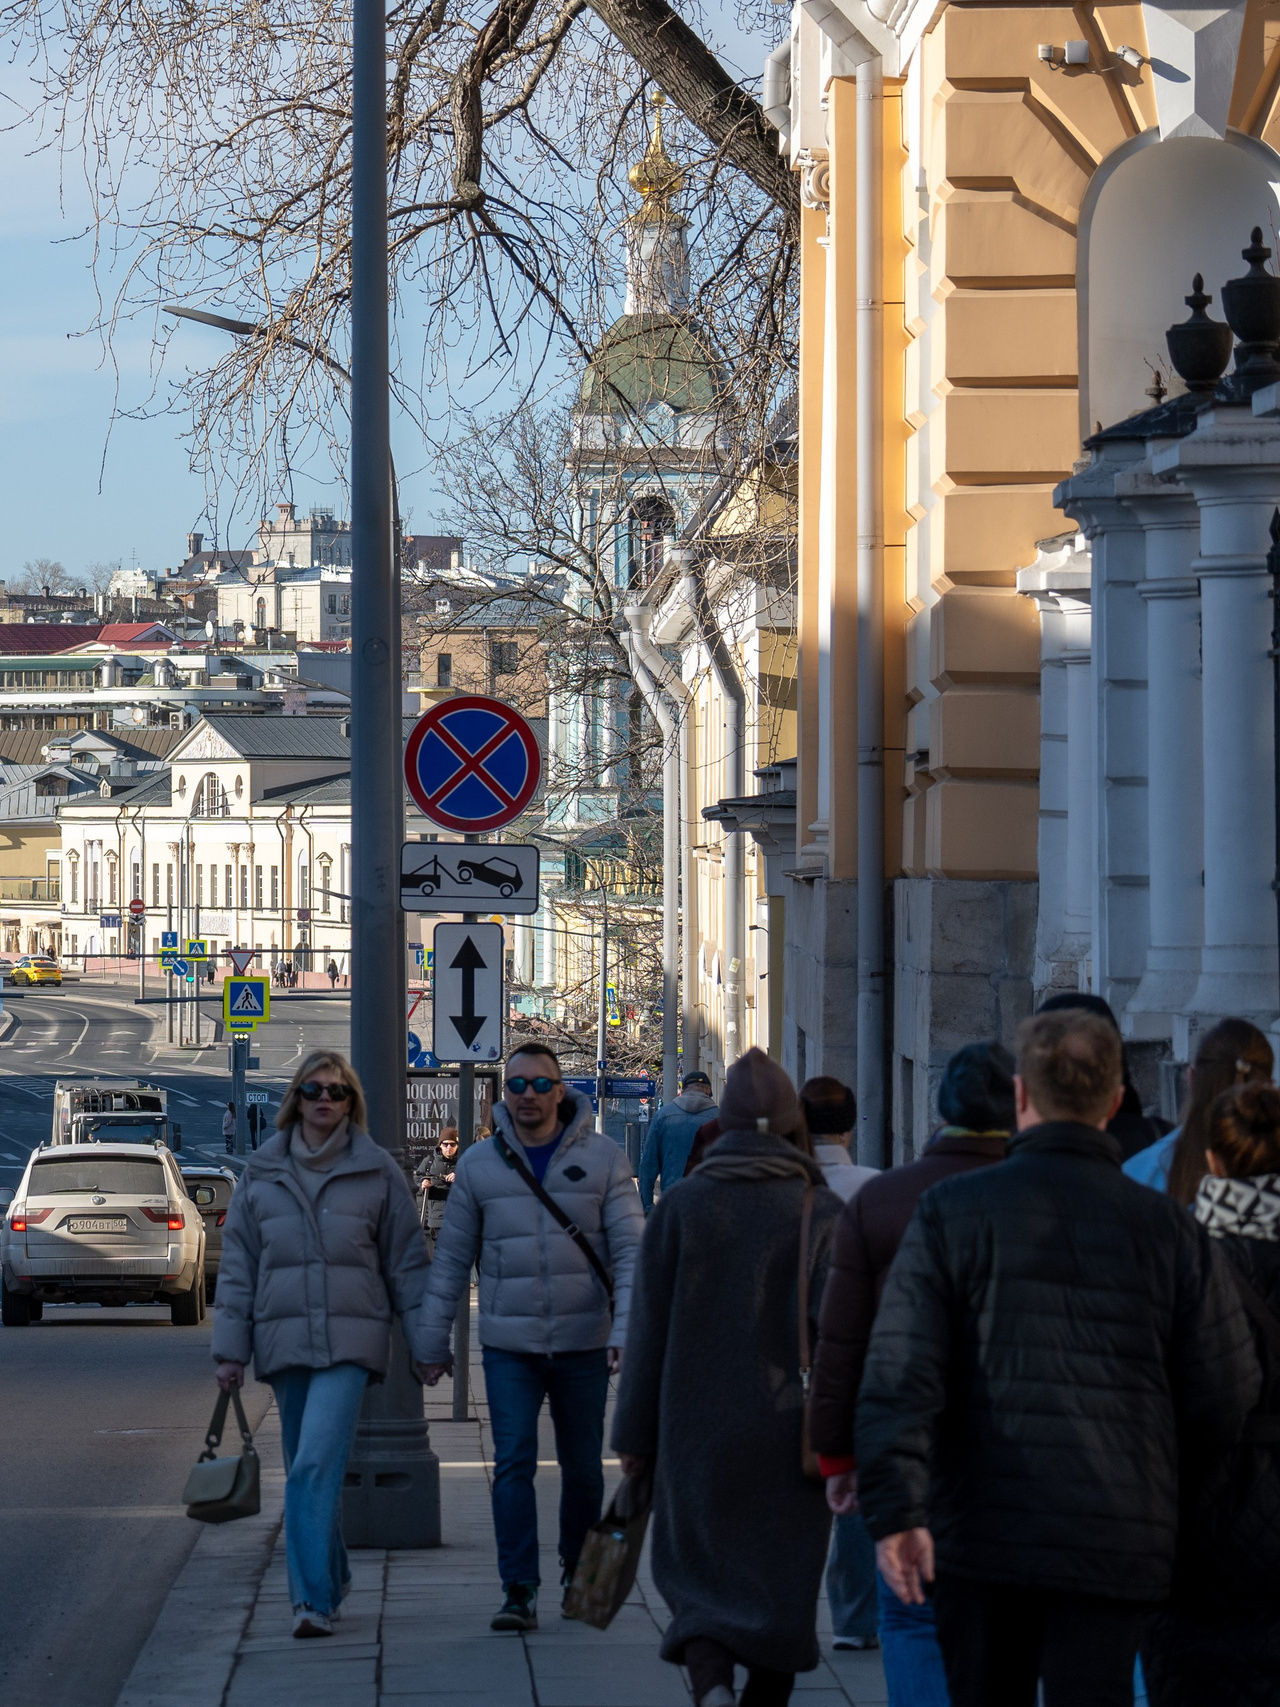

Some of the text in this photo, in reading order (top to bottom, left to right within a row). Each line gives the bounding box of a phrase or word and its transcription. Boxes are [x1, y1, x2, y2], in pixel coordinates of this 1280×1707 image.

[248, 1093, 266, 1102] СТОП
[406, 1103, 448, 1120] ЕДЕЛЯ
[406, 1122, 440, 1139] ОДЫ
[113, 1219, 124, 1227] 50
